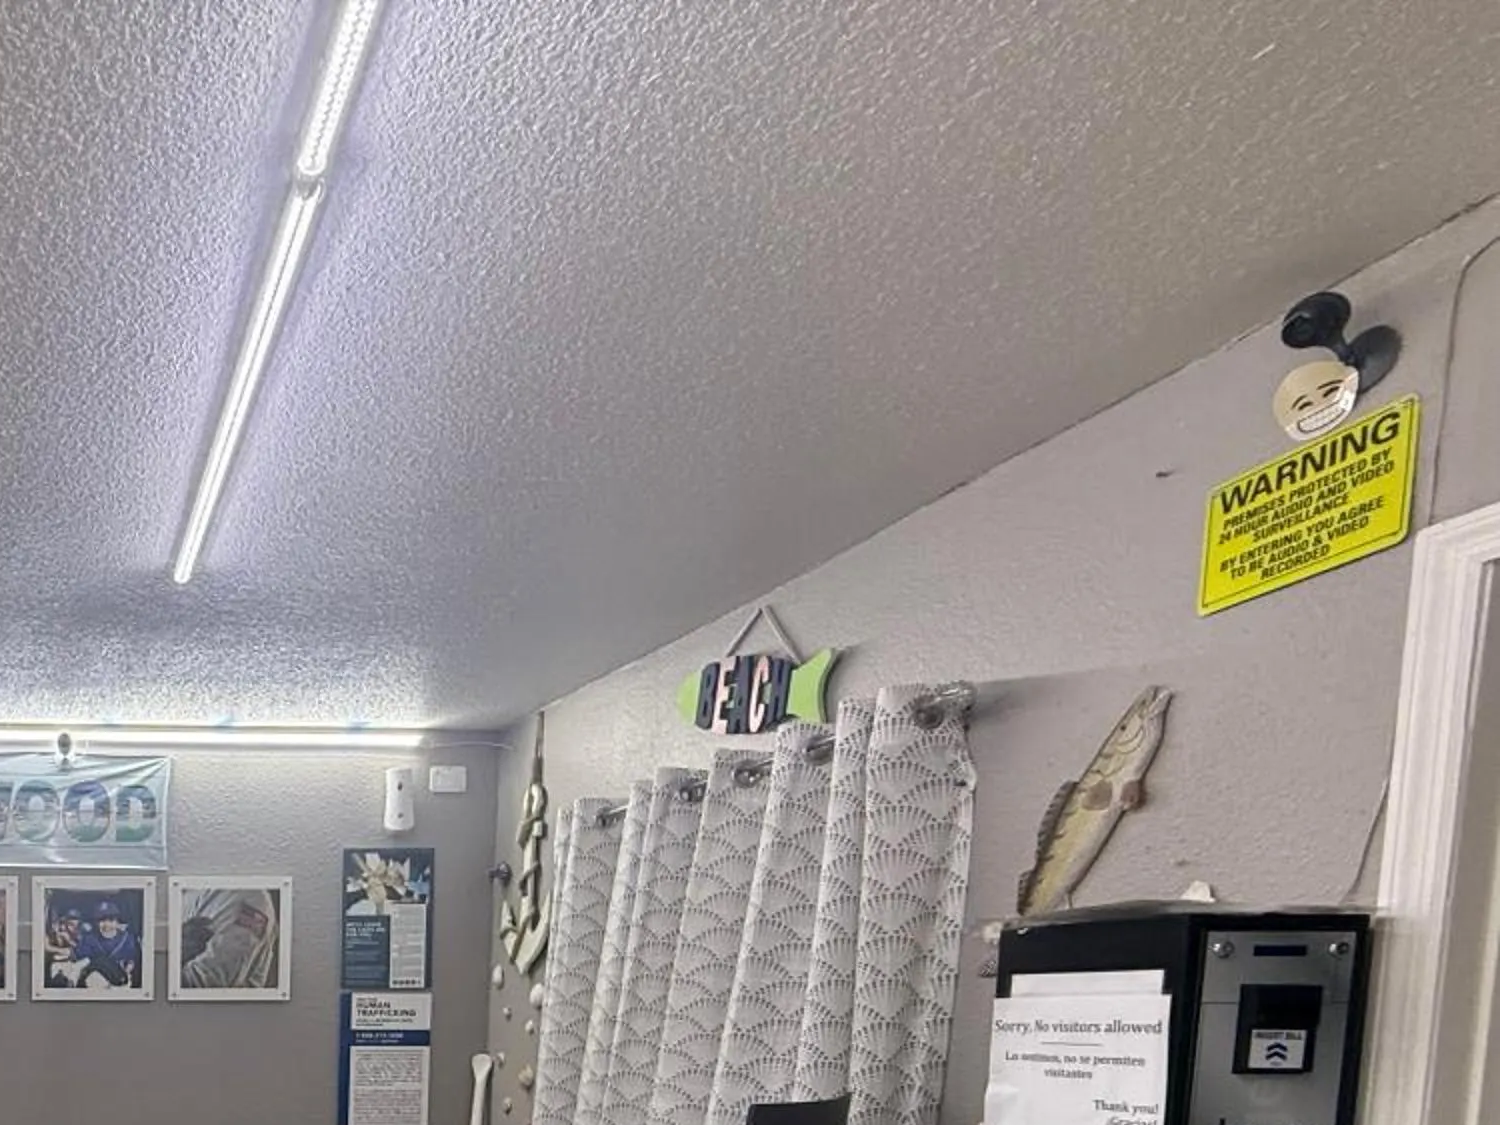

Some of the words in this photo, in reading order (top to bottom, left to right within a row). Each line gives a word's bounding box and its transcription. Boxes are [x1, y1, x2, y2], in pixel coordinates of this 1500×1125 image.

[1220, 411, 1400, 514] WARNING
[1223, 496, 1285, 530] PREMISES
[1290, 461, 1369, 501] PROTECTED
[1371, 446, 1393, 467] BY
[1218, 532, 1232, 545] 24
[1234, 515, 1270, 540] HOUR
[1271, 497, 1312, 522] AUDIO
[1316, 483, 1346, 504] AND
[1351, 460, 1394, 487] VIDEO
[1220, 556, 1238, 573] BY
[1239, 530, 1302, 564] ENTERING
[1306, 516, 1335, 537] YOU
[1337, 496, 1385, 522] AGREE
[1253, 493, 1350, 542] SURVEILLANCE
[1230, 565, 1247, 580] TO
[1249, 558, 1265, 573] BE
[1268, 540, 1310, 565] AUDIO
[1312, 532, 1324, 547] &
[1327, 516, 1370, 541] VIDEO
[1260, 544, 1331, 580] RECORDED
[695, 655, 792, 734] BEACH
[1035, 1019, 1049, 1033] No
[1052, 1019, 1101, 1034] visitors
[1104, 1019, 1162, 1035] allowed
[1064, 1055, 1076, 1063] no
[1092, 1099, 1129, 1113] Thank
[1132, 1103, 1158, 1117] you!
